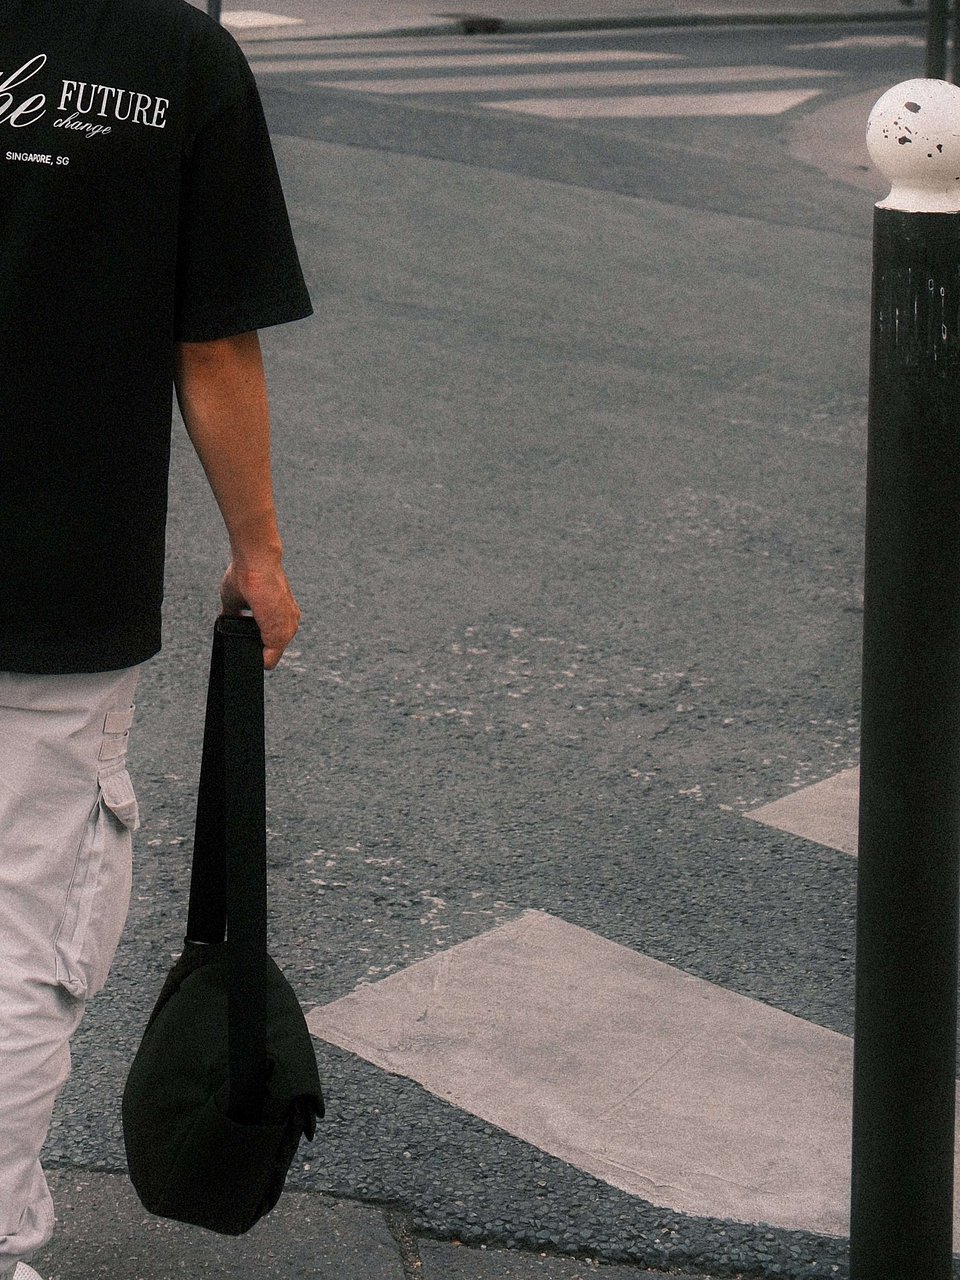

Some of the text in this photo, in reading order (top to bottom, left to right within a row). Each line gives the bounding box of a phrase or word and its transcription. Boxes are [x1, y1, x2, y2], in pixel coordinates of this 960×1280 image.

[57, 79, 170, 129] FUTURE
[53, 111, 112, 139] change
[55, 155, 70, 166] SG
